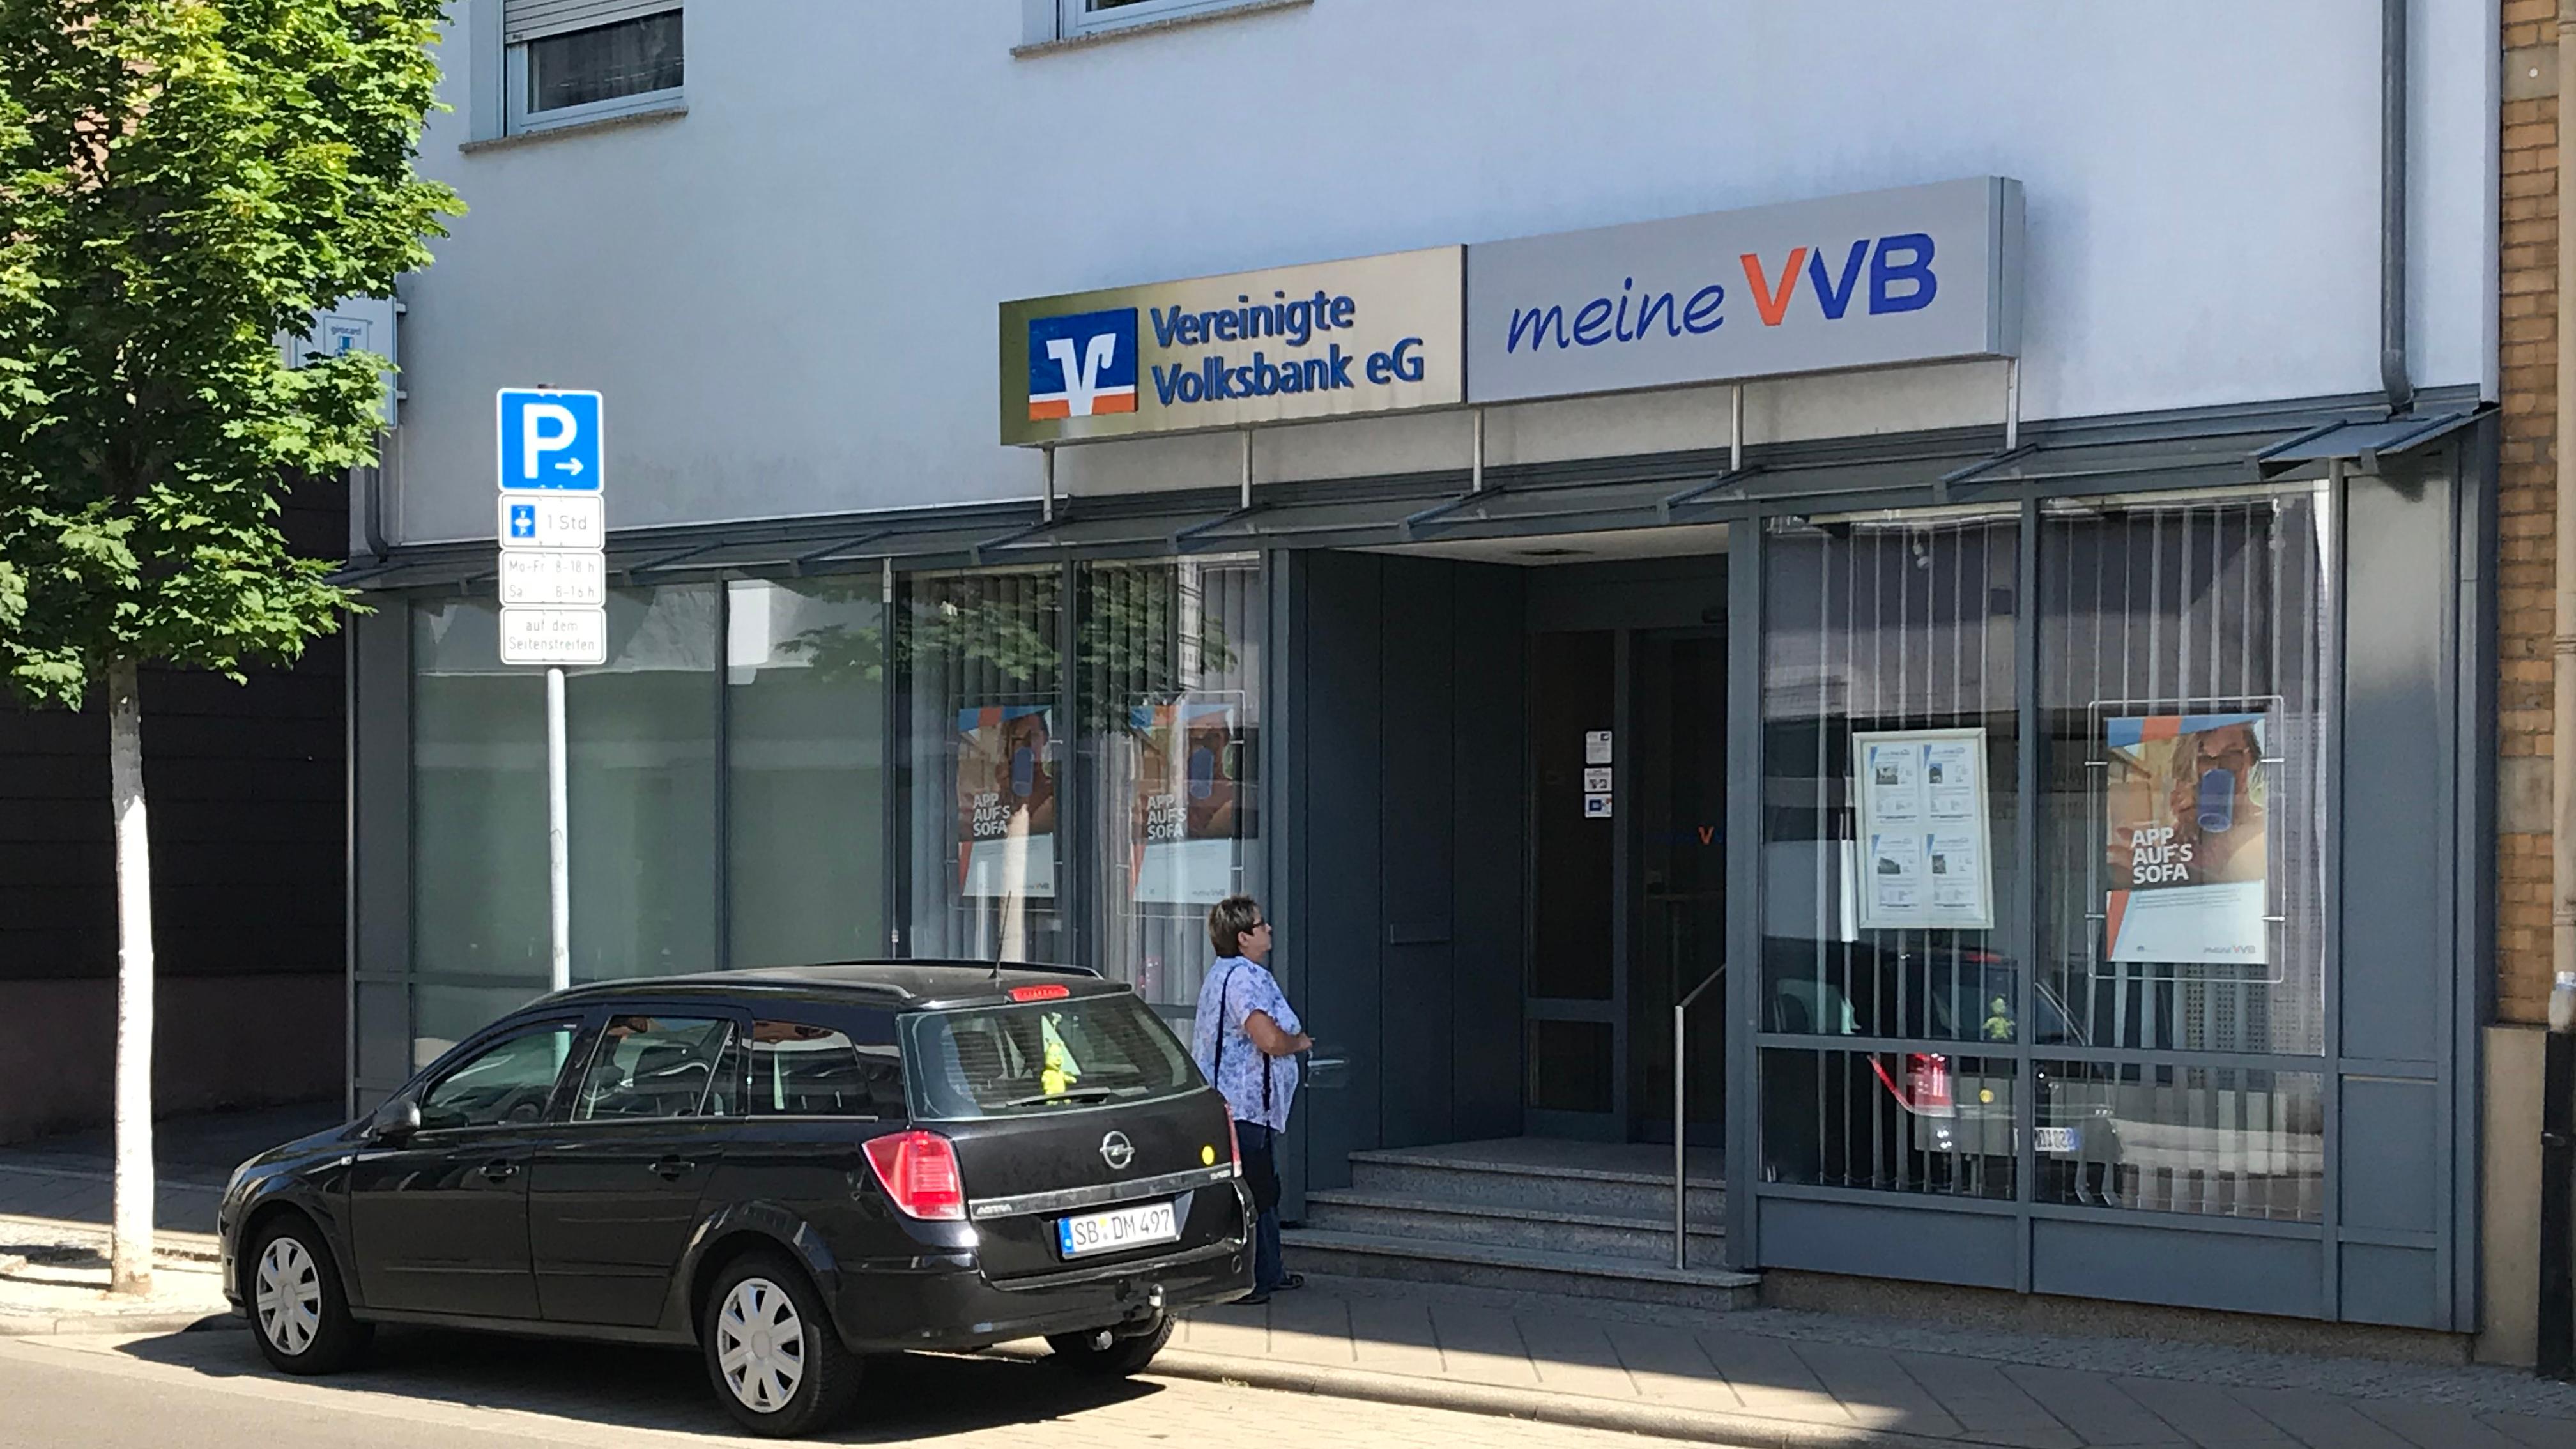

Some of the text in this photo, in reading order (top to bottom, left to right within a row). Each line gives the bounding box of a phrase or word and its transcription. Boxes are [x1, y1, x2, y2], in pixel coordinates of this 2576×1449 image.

[1506, 232, 1938, 355] meine VVB
[1150, 290, 1356, 349] Vereinigte
[1151, 337, 1425, 408] Volksbank eG
[523, 403, 578, 479] P
[559, 515, 587, 530] Std
[509, 560, 594, 573] Mo-Fr 8-18 h
[509, 585, 523, 598] Sa
[588, 585, 595, 598] h
[526, 618, 578, 632] auf dem
[509, 636, 594, 651] Seitenstreifen
[972, 793, 999, 809] APP
[1146, 793, 1174, 810] APP
[972, 820, 1008, 837] SOFA
[1147, 822, 1184, 840] SOFA
[2130, 827, 2175, 849] APP
[2132, 863, 2189, 884] SOFA
[1074, 1209, 1170, 1245] SB DM 497
